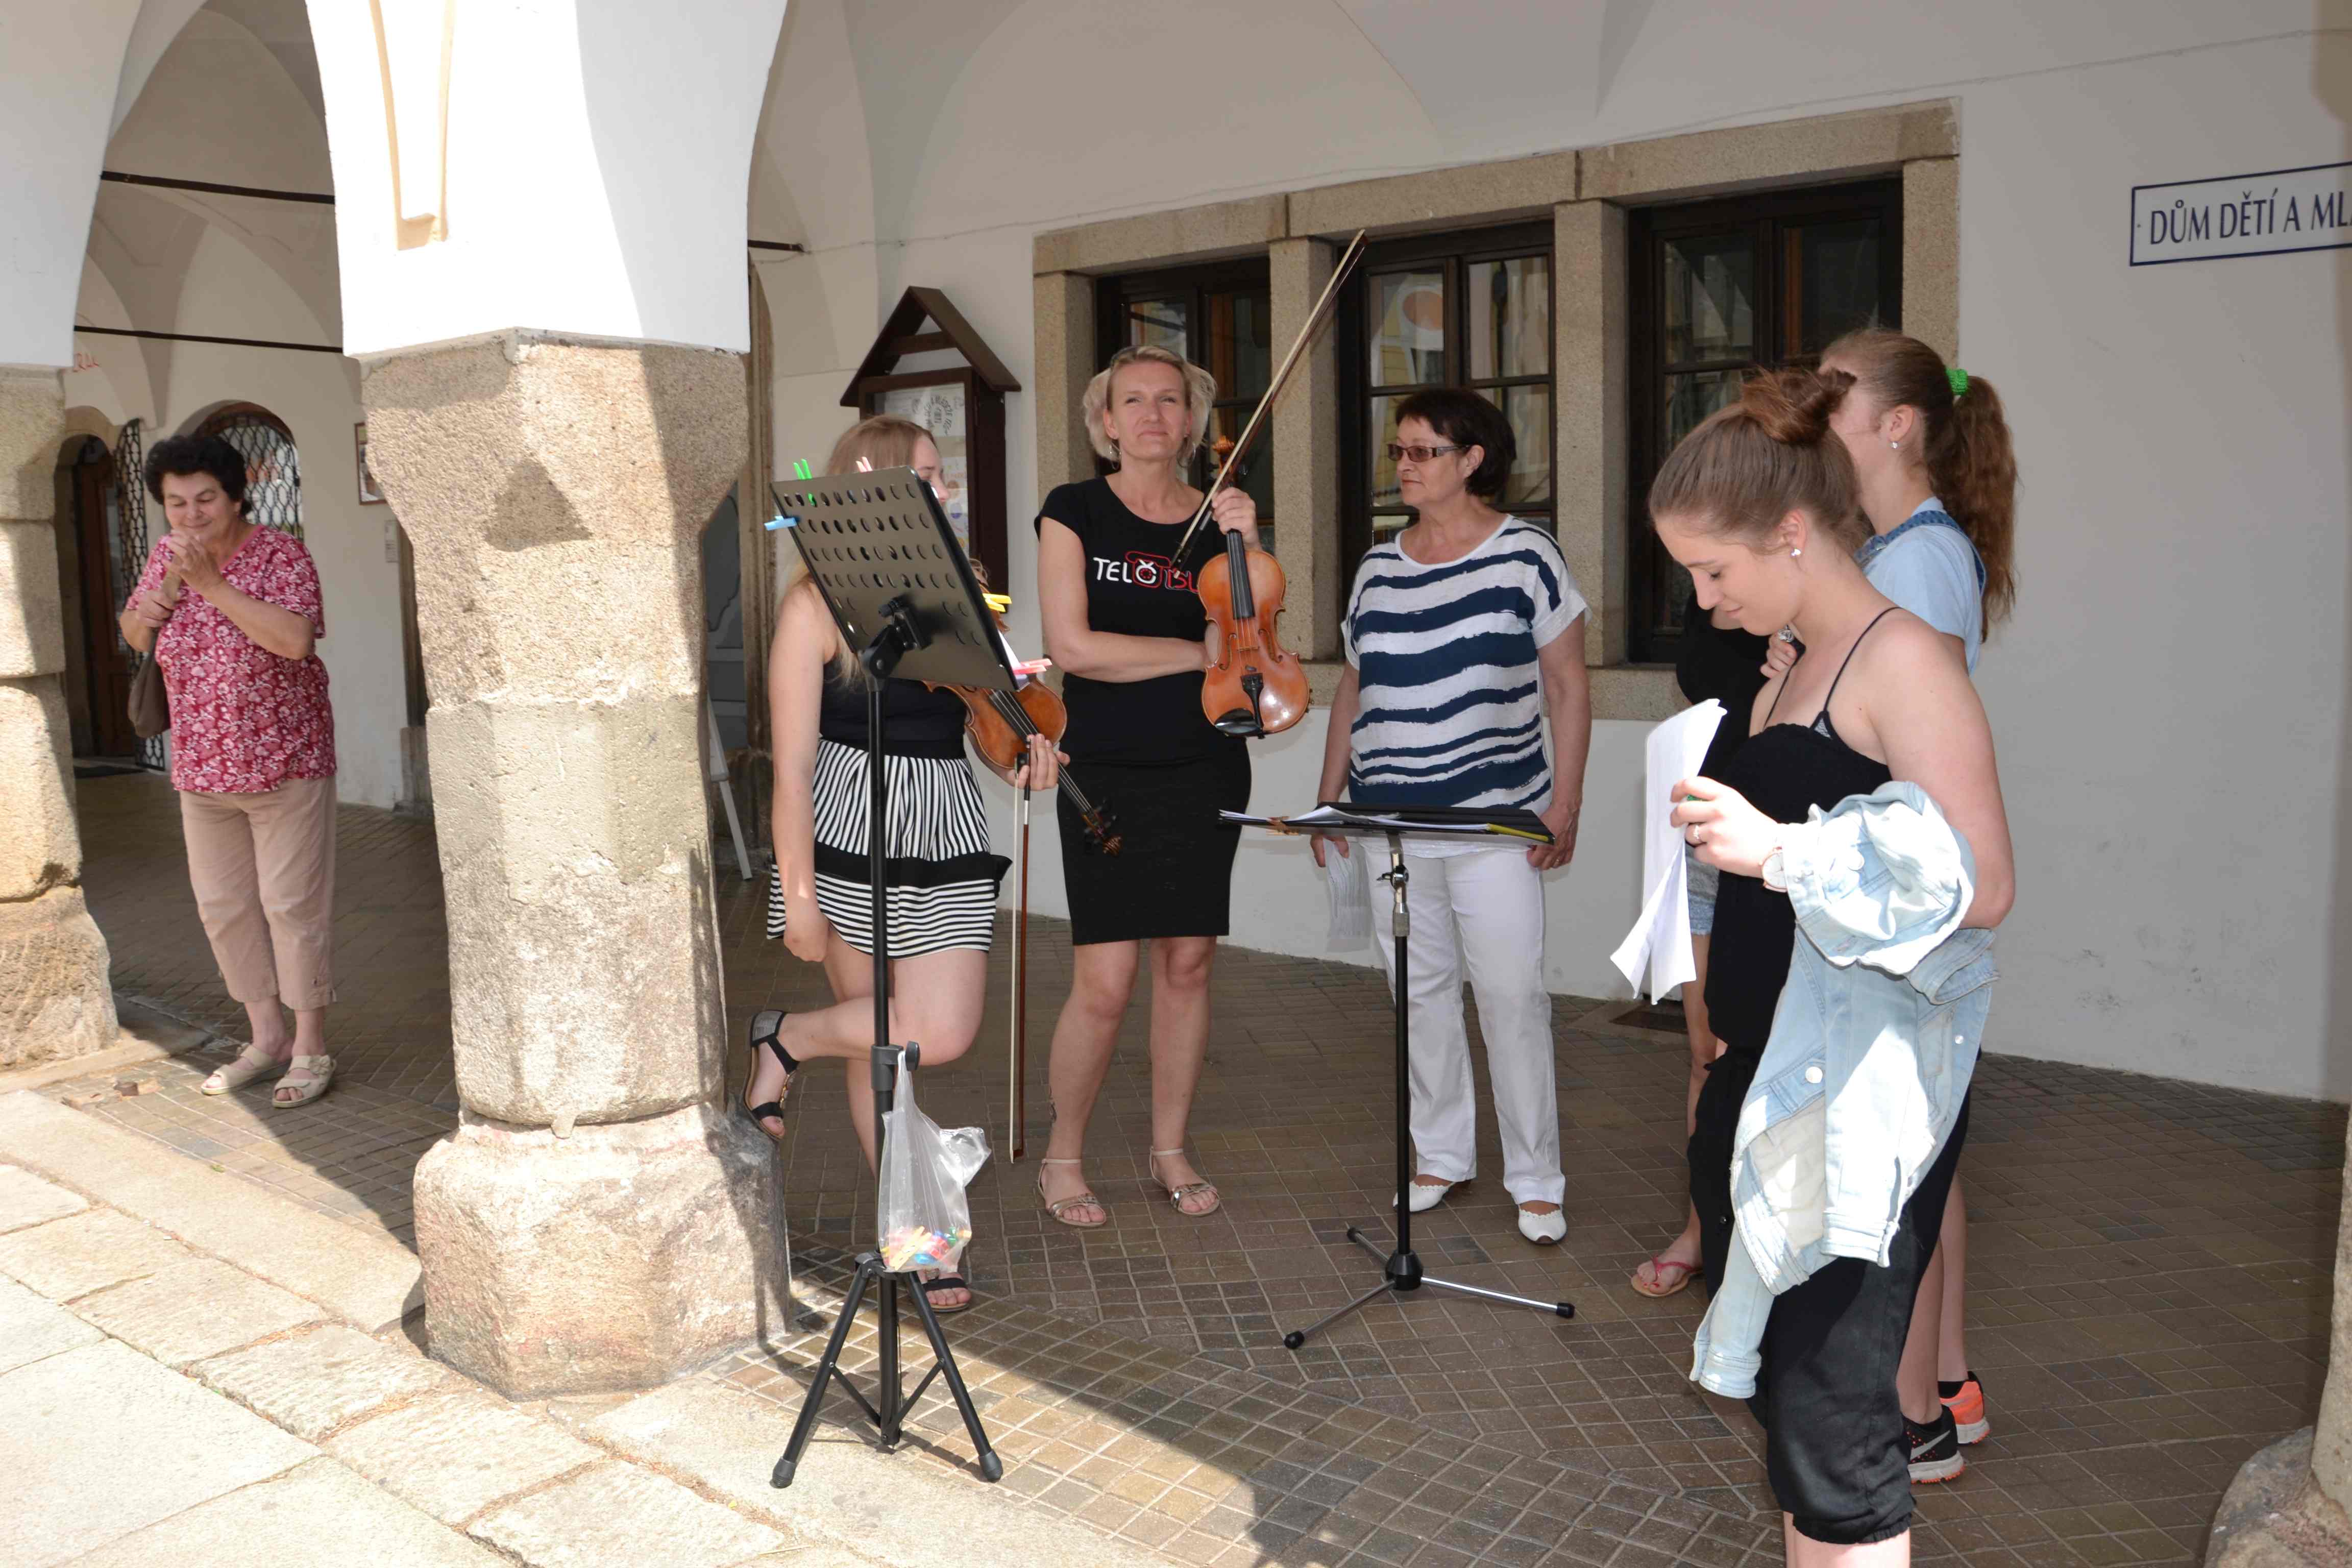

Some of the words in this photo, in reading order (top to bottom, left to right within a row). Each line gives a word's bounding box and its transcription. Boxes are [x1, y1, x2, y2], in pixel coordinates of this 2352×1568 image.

[2150, 200, 2210, 245] DŮM
[2219, 187, 2278, 239] DĚTÍ
[2283, 196, 2301, 232] A
[2311, 191, 2352, 231] ML
